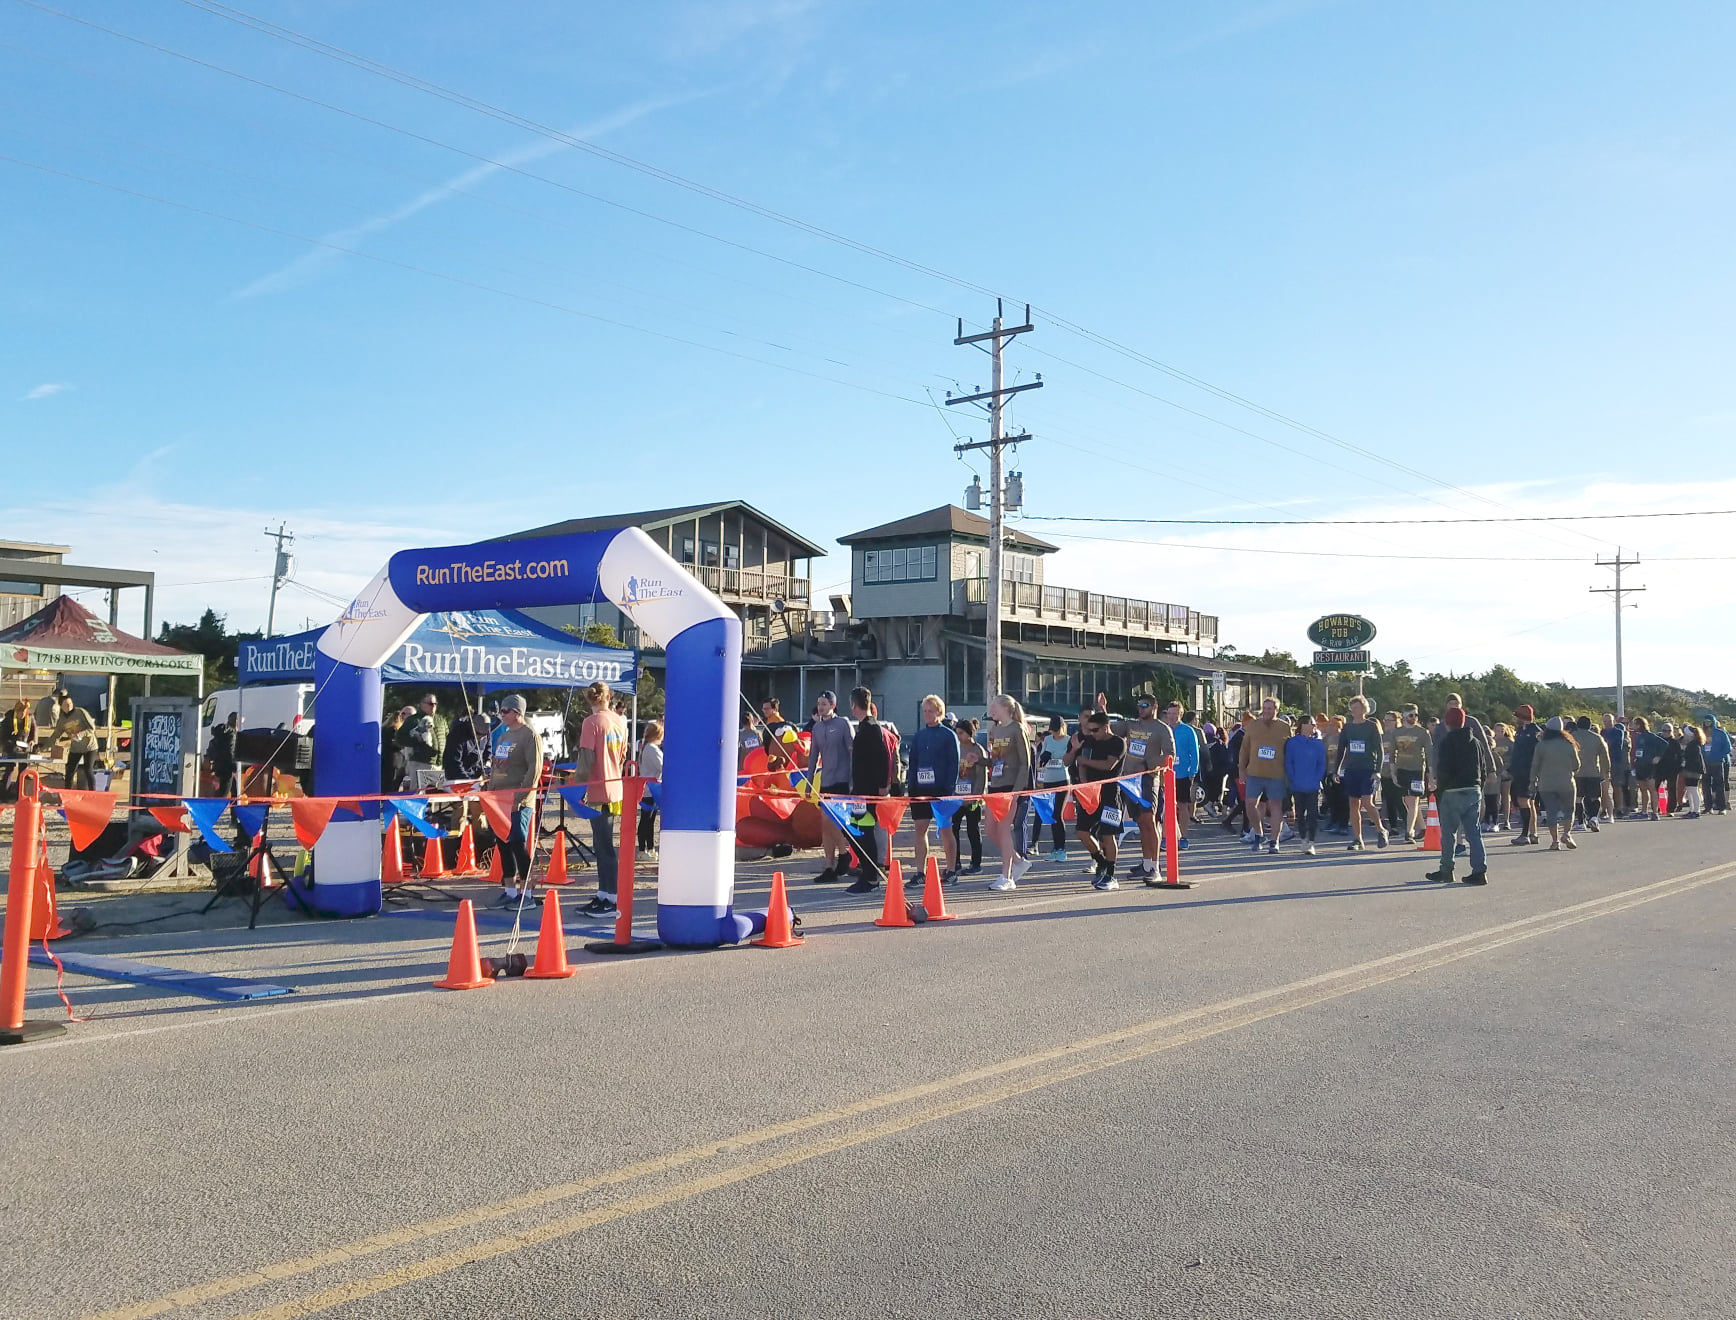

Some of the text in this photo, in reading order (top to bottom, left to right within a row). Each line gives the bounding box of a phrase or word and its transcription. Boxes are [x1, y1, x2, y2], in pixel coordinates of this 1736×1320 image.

[416, 559, 569, 585] RunTheEast.com
[640, 578, 662, 588] Run
[639, 587, 683, 598] The East
[354, 599, 369, 608] Run
[369, 608, 387, 618] East
[1318, 616, 1362, 632] HOWARD'S
[473, 624, 536, 637] The East
[1331, 628, 1348, 638] PUB
[1329, 639, 1342, 647] RAW
[1346, 636, 1359, 647] BAR
[36, 653, 193, 670] 1718 BREWING OCRACOKE
[403, 643, 622, 681] RunTheEast.com
[1315, 652, 1365, 662] RESTAURANT
[151, 715, 176, 737] 1718
[149, 760, 174, 784] OPEN
